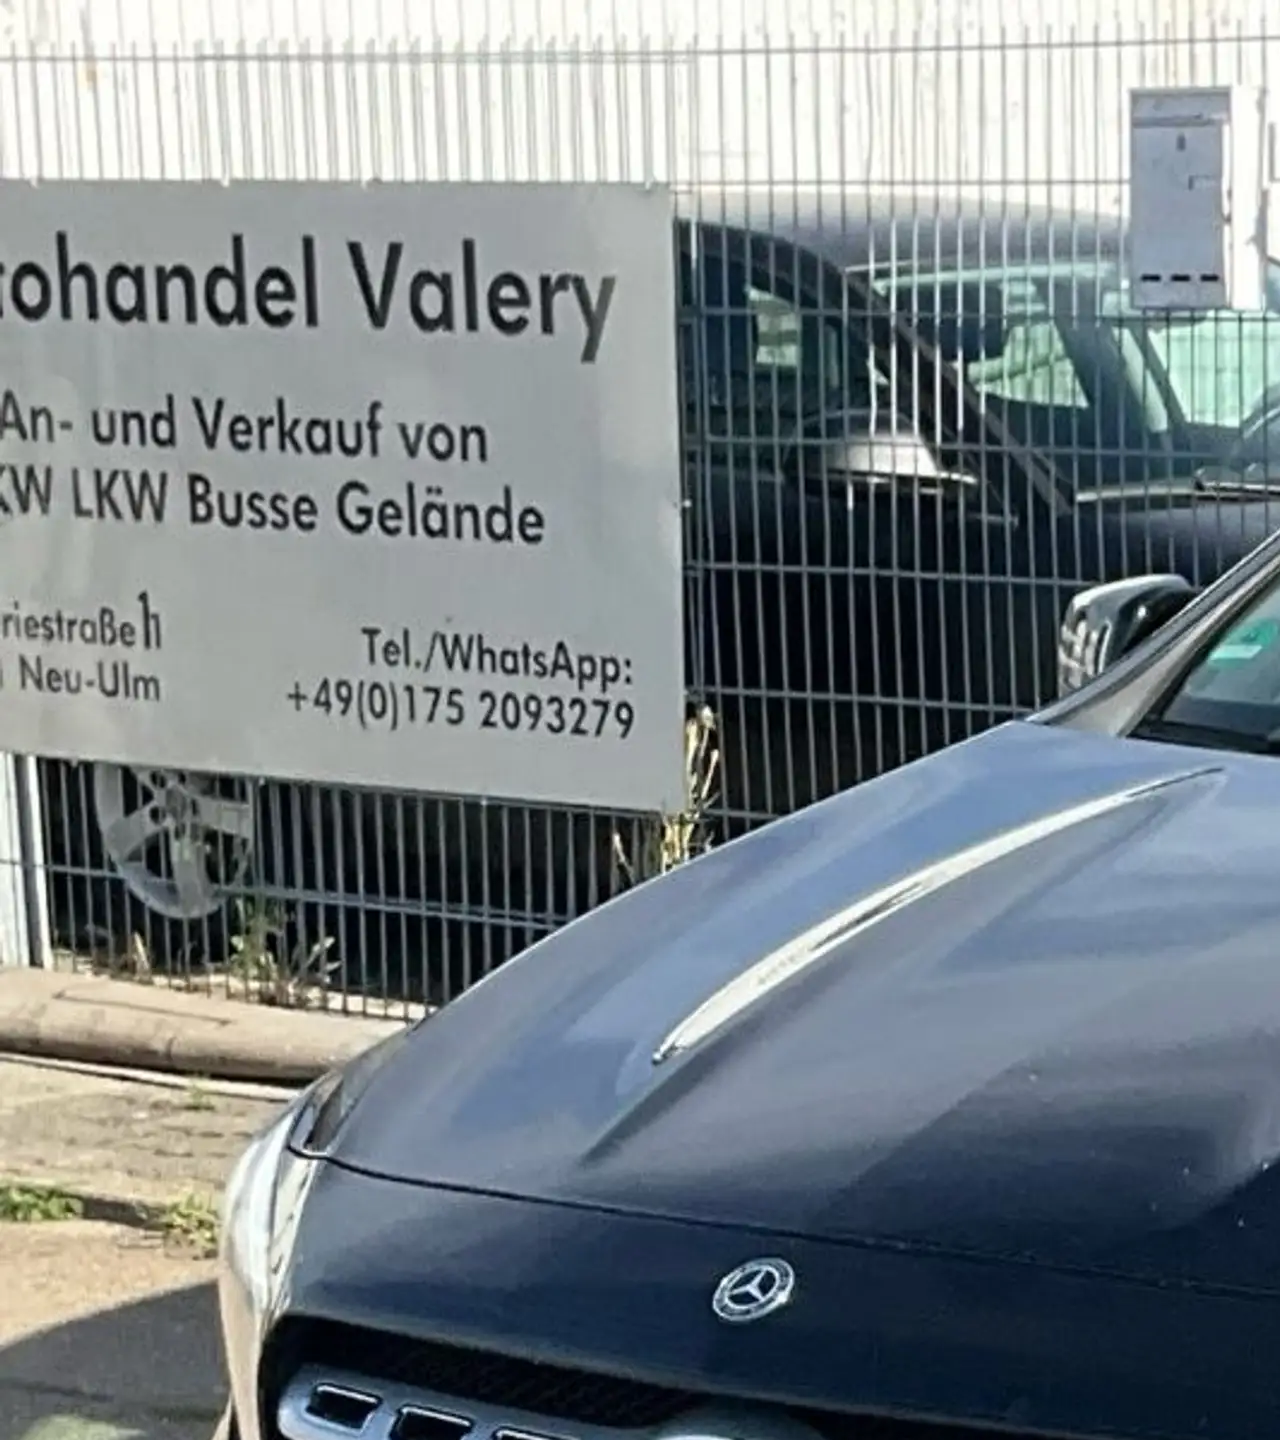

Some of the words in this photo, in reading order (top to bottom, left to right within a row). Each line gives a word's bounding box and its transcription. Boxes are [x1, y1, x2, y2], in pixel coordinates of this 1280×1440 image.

[0, 229, 319, 329] ohandel
[346, 236, 617, 364] Valery
[0, 388, 74, 443] An-
[91, 392, 178, 449] und
[191, 395, 384, 458] Verkauf
[396, 421, 489, 464] von
[71, 466, 169, 524] LKW
[187, 472, 320, 533] Busse
[336, 478, 546, 546] Gelände
[18, 653, 161, 702] Neu-Ulm
[360, 625, 634, 693] Tel./WhatsApp:
[287, 676, 466, 732] +49(0)175
[478, 689, 636, 741] 2093279
